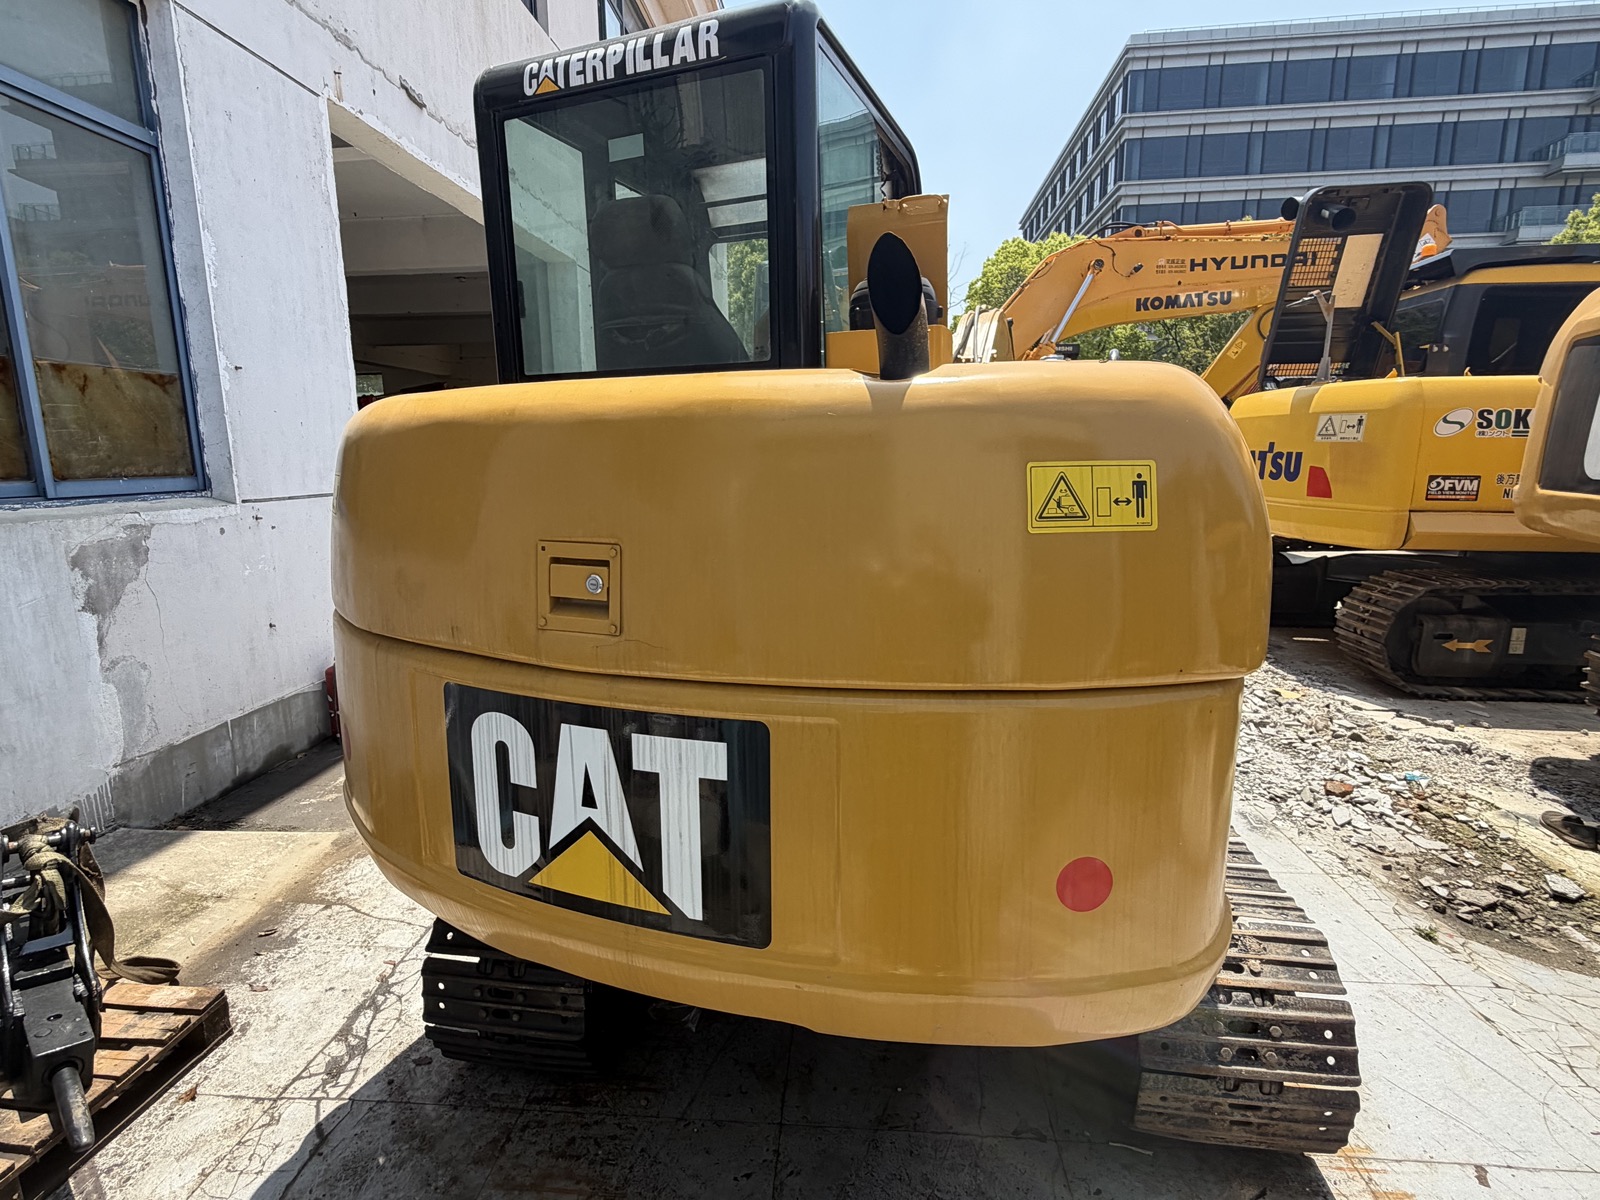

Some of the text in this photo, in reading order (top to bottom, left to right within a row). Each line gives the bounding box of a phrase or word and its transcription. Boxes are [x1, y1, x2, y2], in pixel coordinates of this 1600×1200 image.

[523, 19, 719, 96] CATERPILLAR
[1189, 251, 1317, 272] HYUNDAI
[1135, 290, 1232, 312] KOMATSU
[1444, 479, 1479, 491] FVM
[471, 711, 728, 921] CAT
